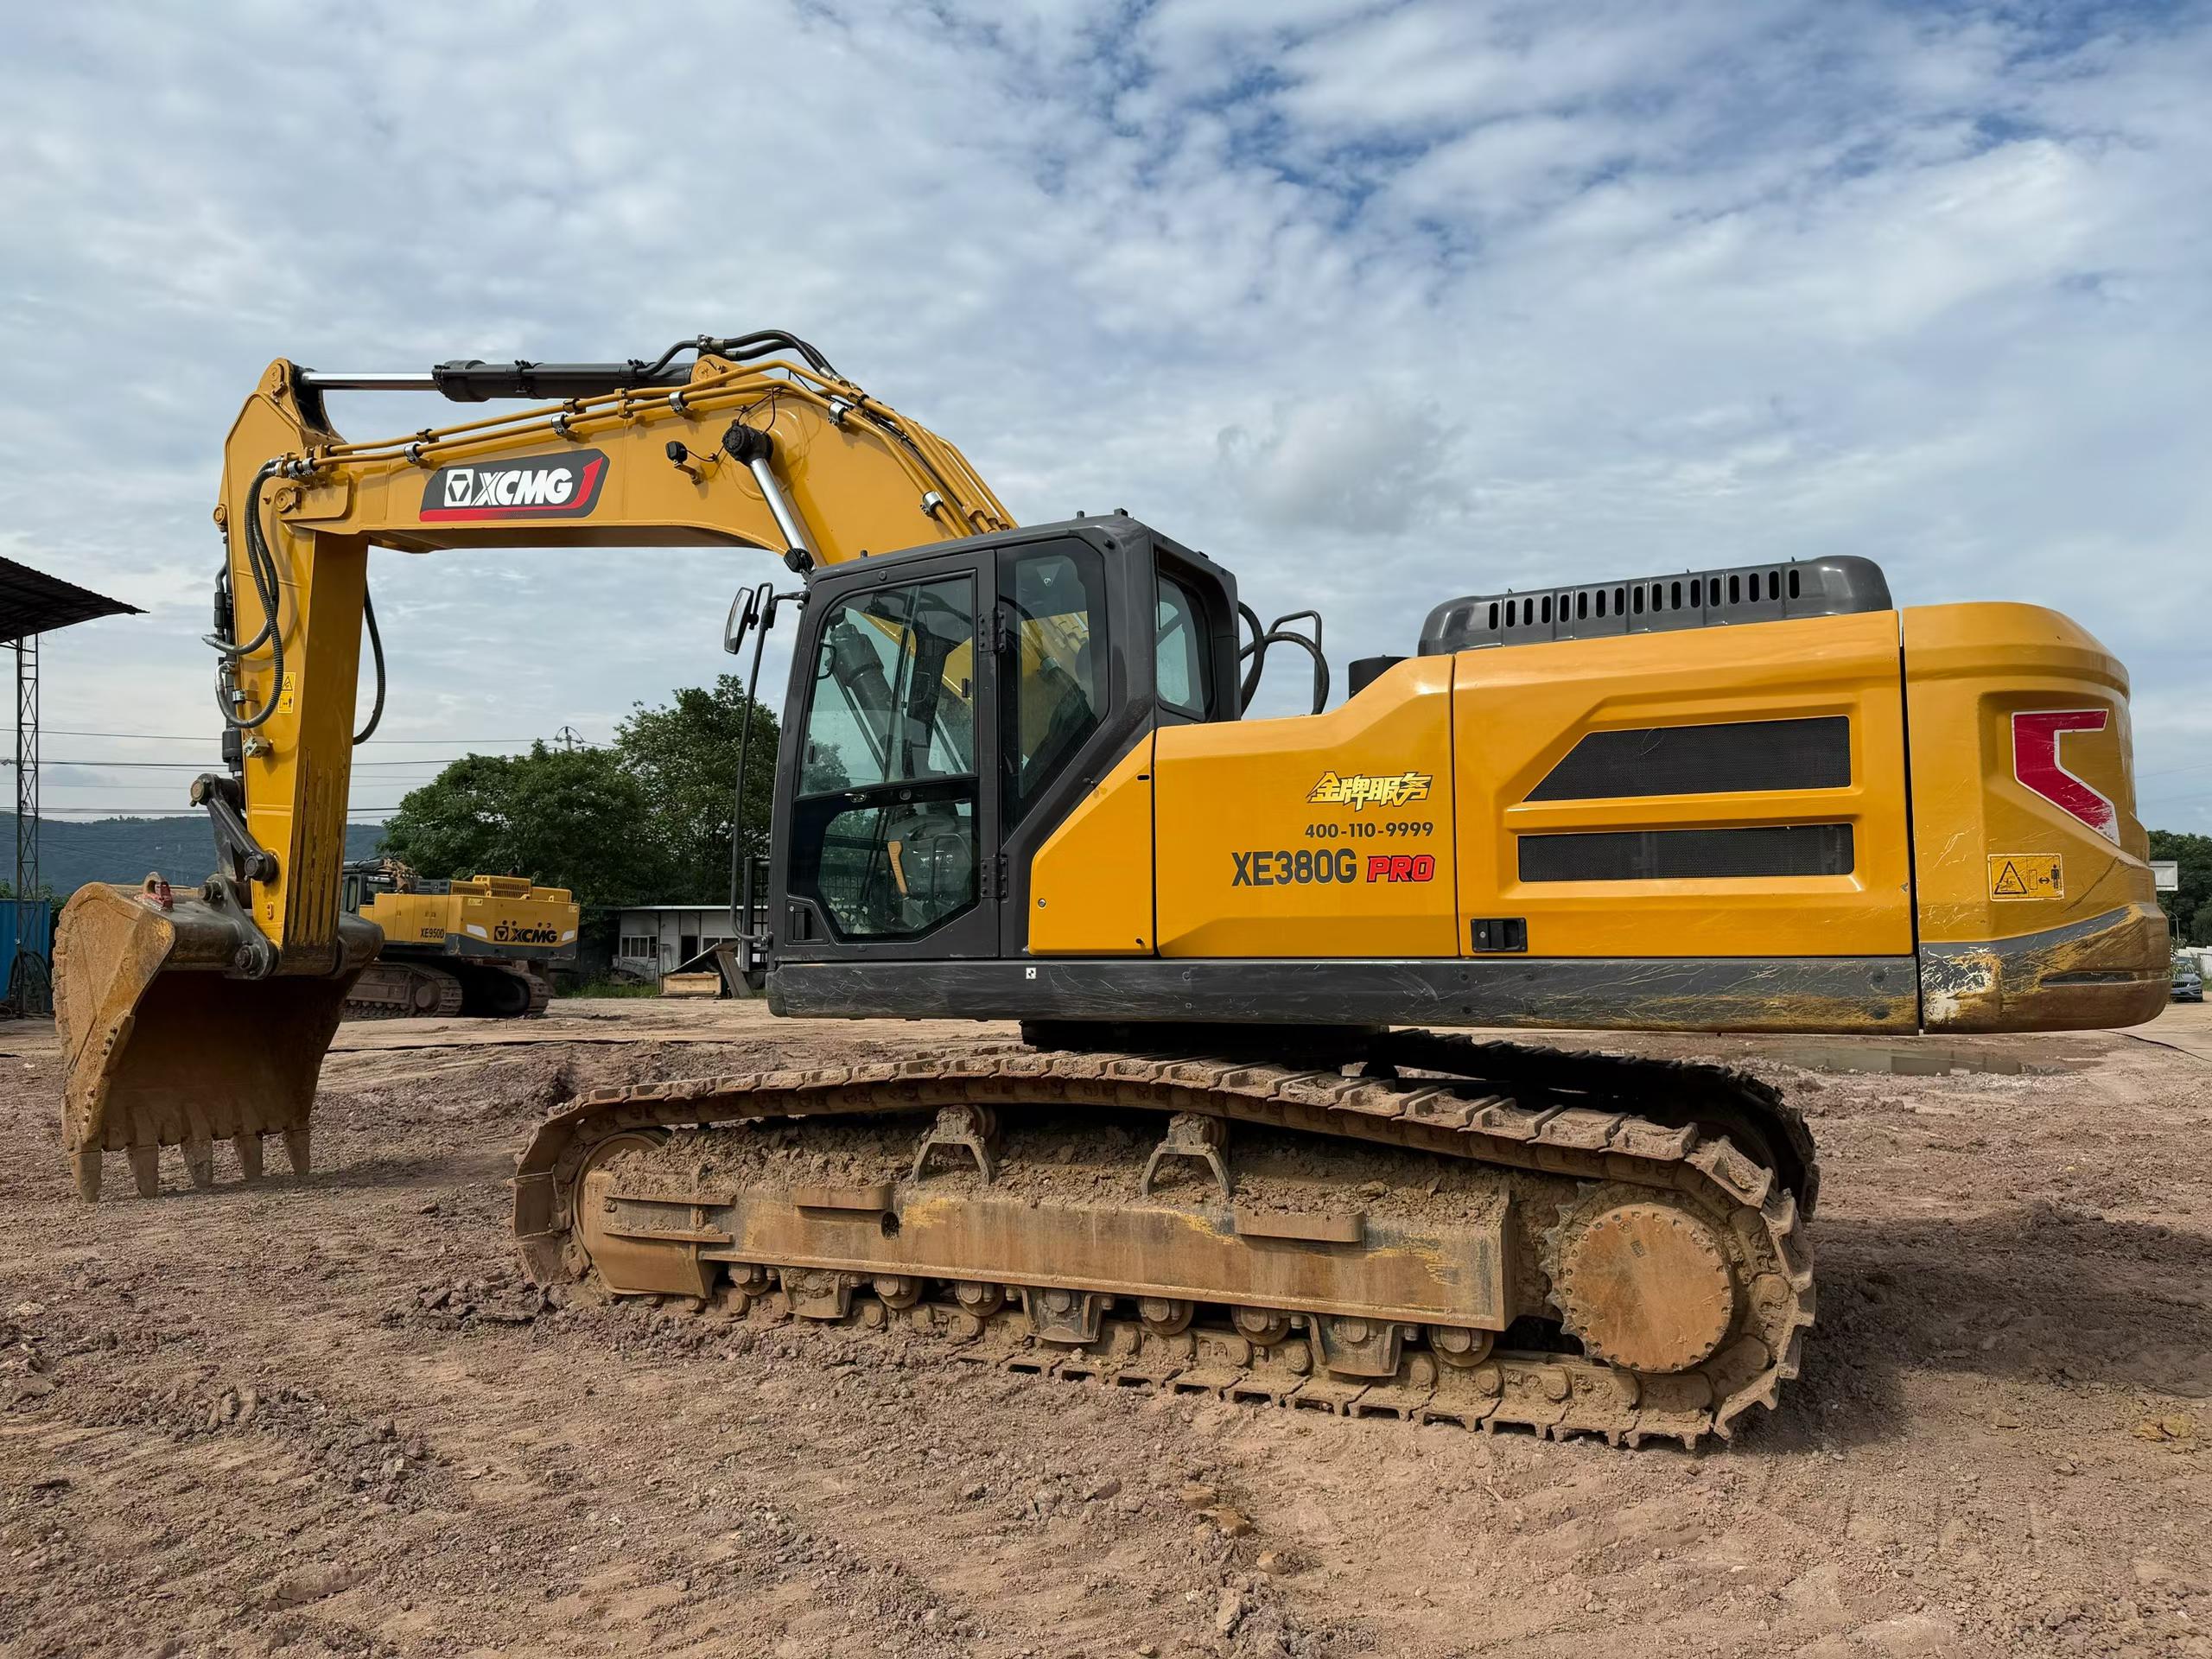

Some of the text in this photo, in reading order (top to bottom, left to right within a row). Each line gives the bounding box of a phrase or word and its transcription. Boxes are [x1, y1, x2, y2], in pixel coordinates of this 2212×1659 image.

[471, 467, 573, 505] XCMG
[1306, 771, 1433, 811] 金牌服务
[1305, 822, 1433, 837] 400-110-9999
[1231, 849, 1435, 887] XE380G PRO
[509, 927, 557, 943] XCMG
